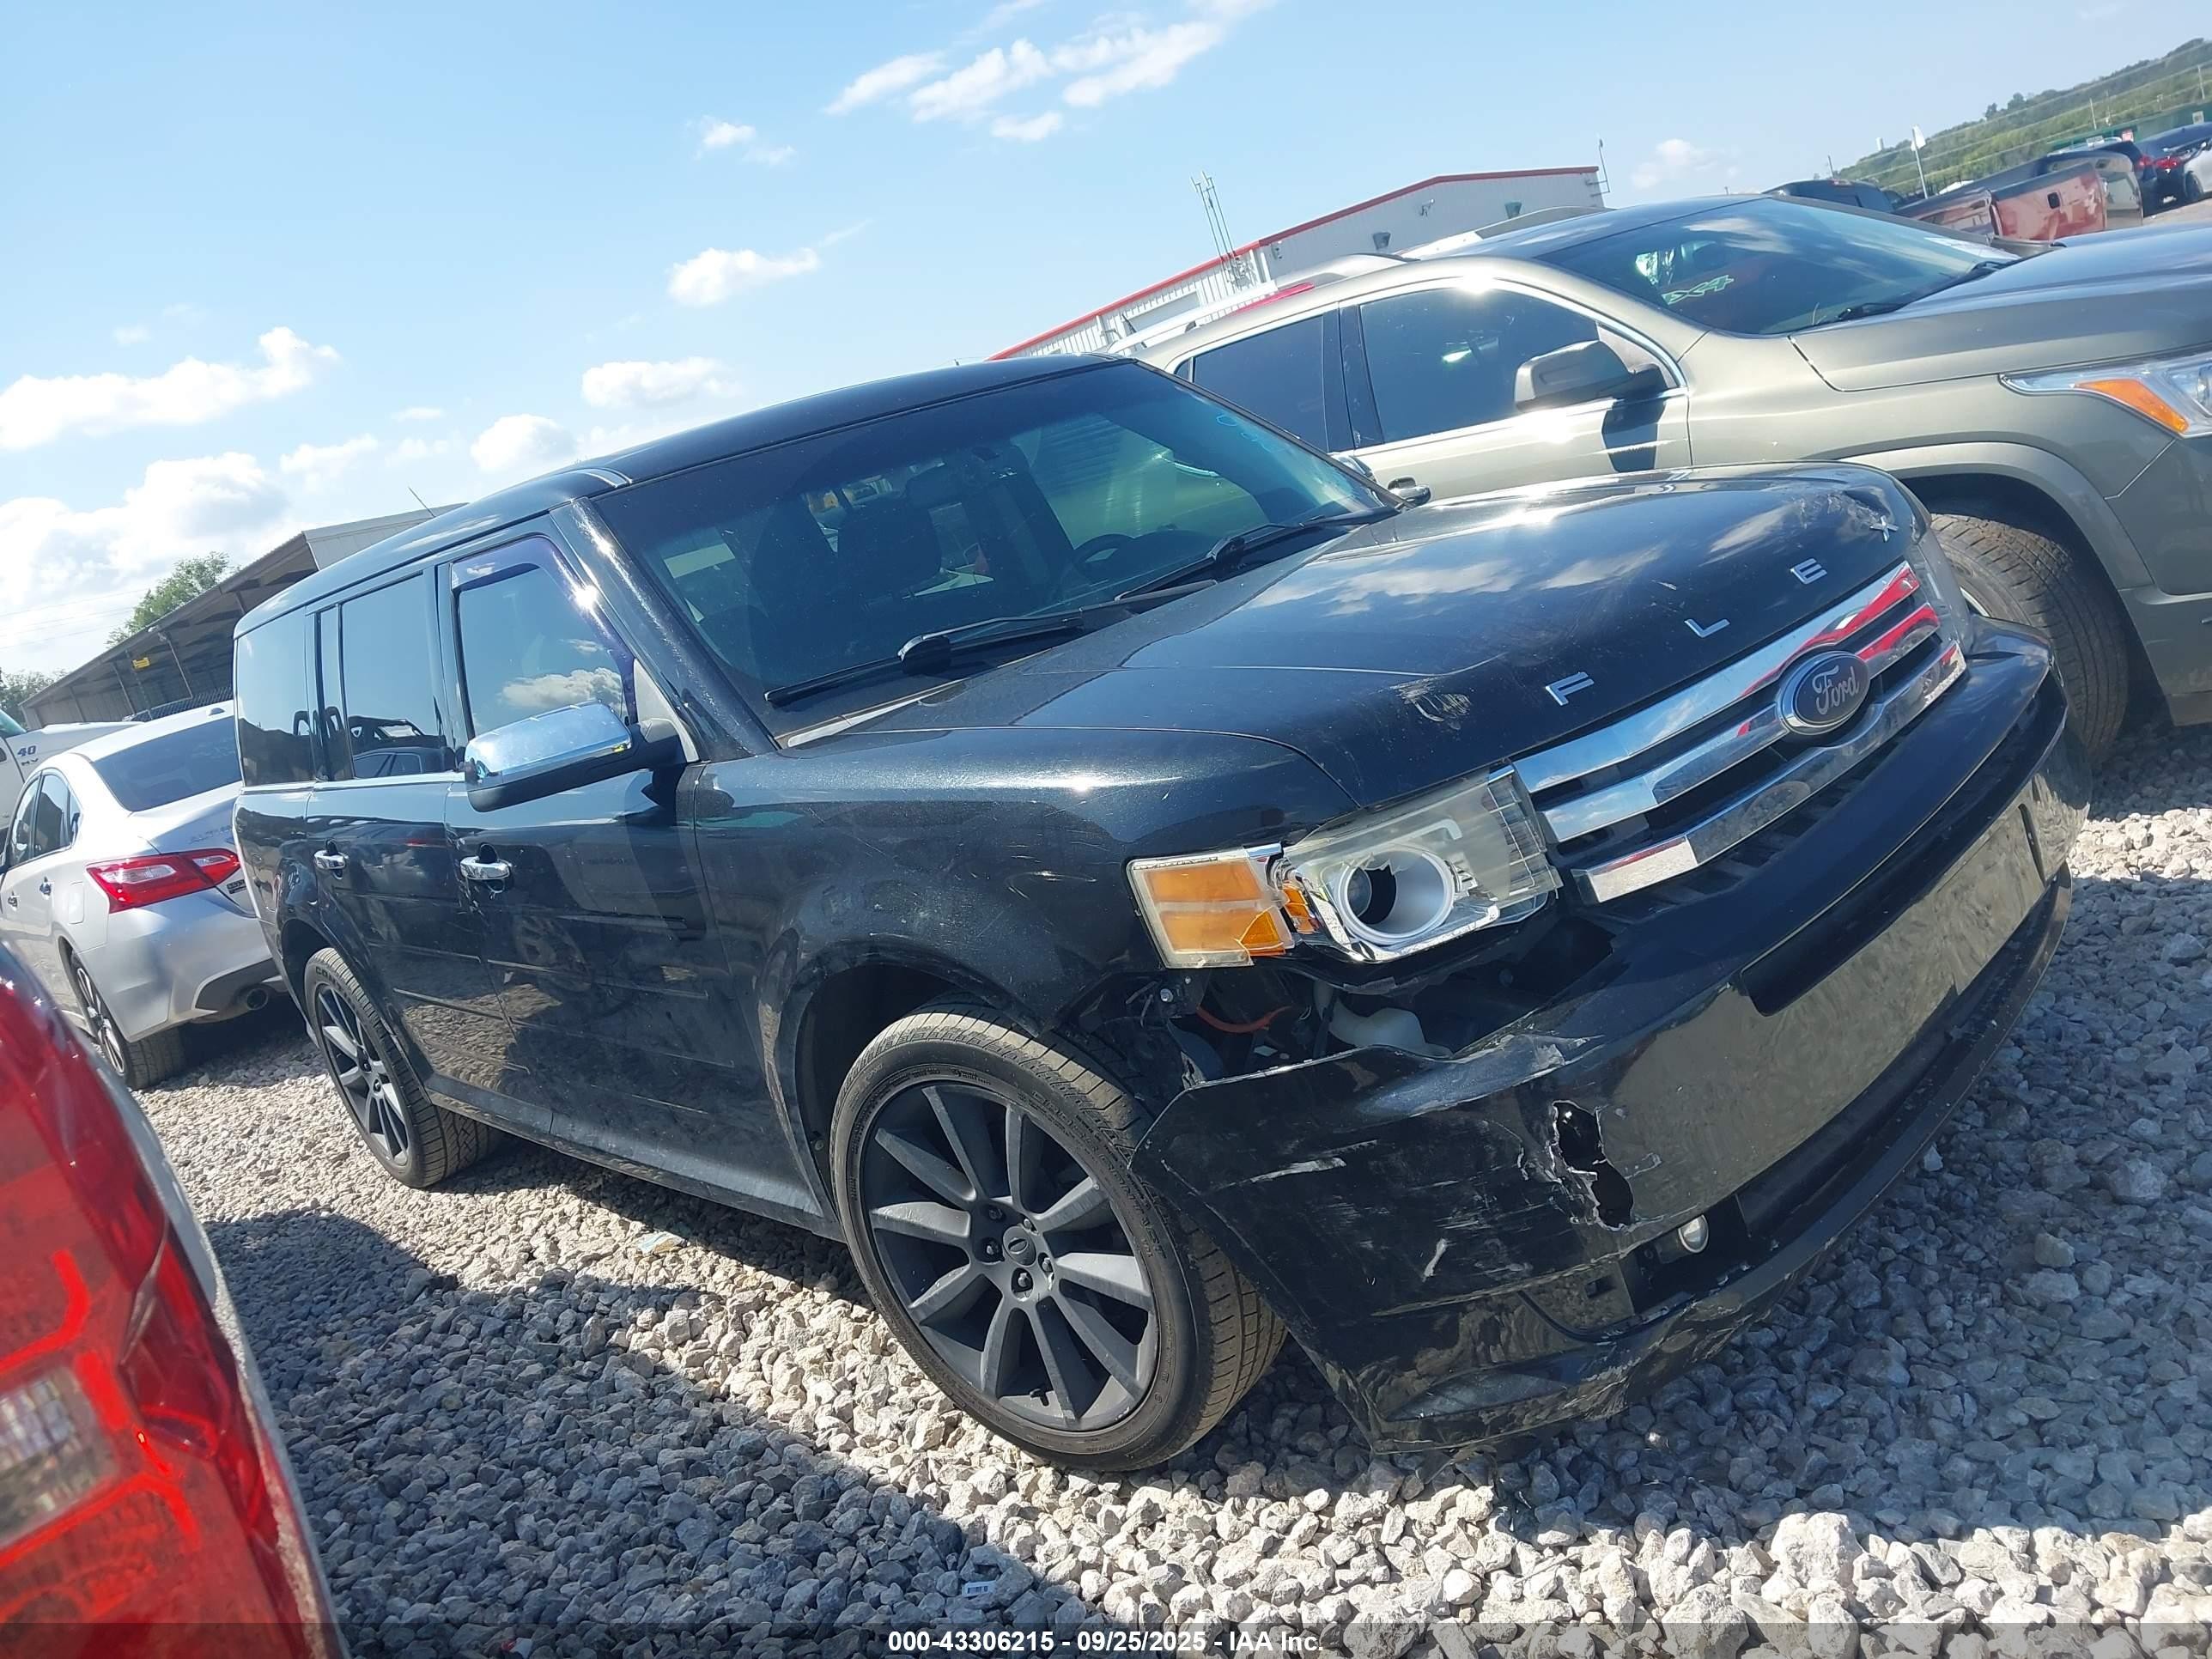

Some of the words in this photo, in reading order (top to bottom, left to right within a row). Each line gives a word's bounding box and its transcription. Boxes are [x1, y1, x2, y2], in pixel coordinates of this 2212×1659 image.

[1546, 515, 1899, 706] FLEX
[1812, 665, 1860, 715] Ford
[17, 745, 37, 757] 40
